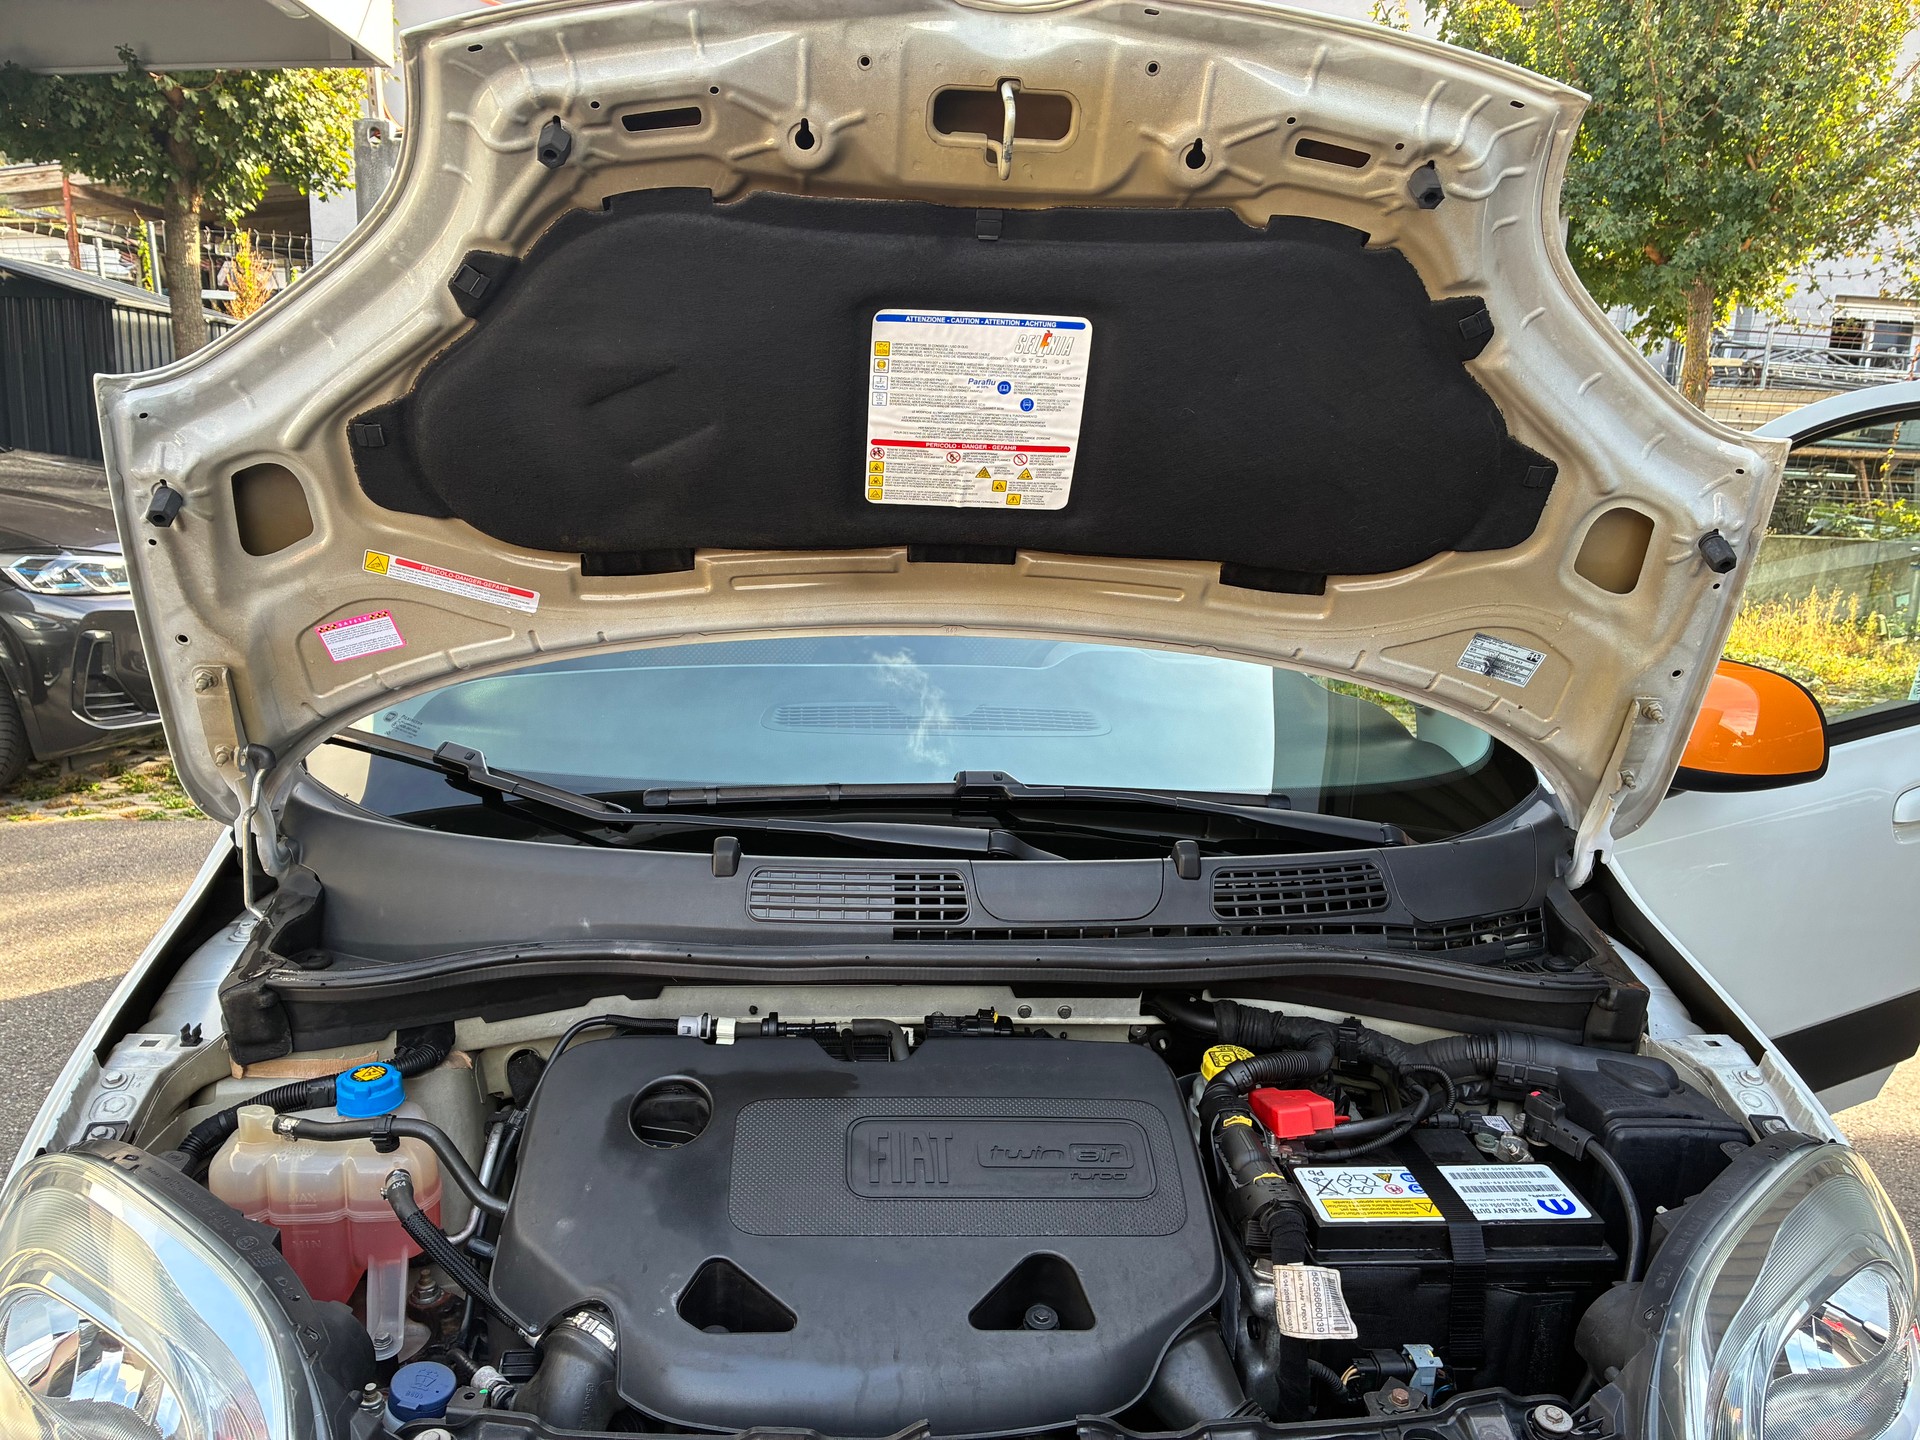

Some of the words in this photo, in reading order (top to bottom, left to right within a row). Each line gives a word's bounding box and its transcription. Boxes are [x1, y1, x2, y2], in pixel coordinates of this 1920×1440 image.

[1025, 320, 1056, 328] ACHTUNG
[967, 377, 996, 387] Paraflu
[868, 1130, 953, 1184] FIAT
[990, 1145, 1066, 1161] twin
[1076, 1147, 1122, 1162] air
[1070, 1172, 1128, 1181] turbo
[391, 1180, 407, 1191] 4X4
[288, 1192, 317, 1203] MAX
